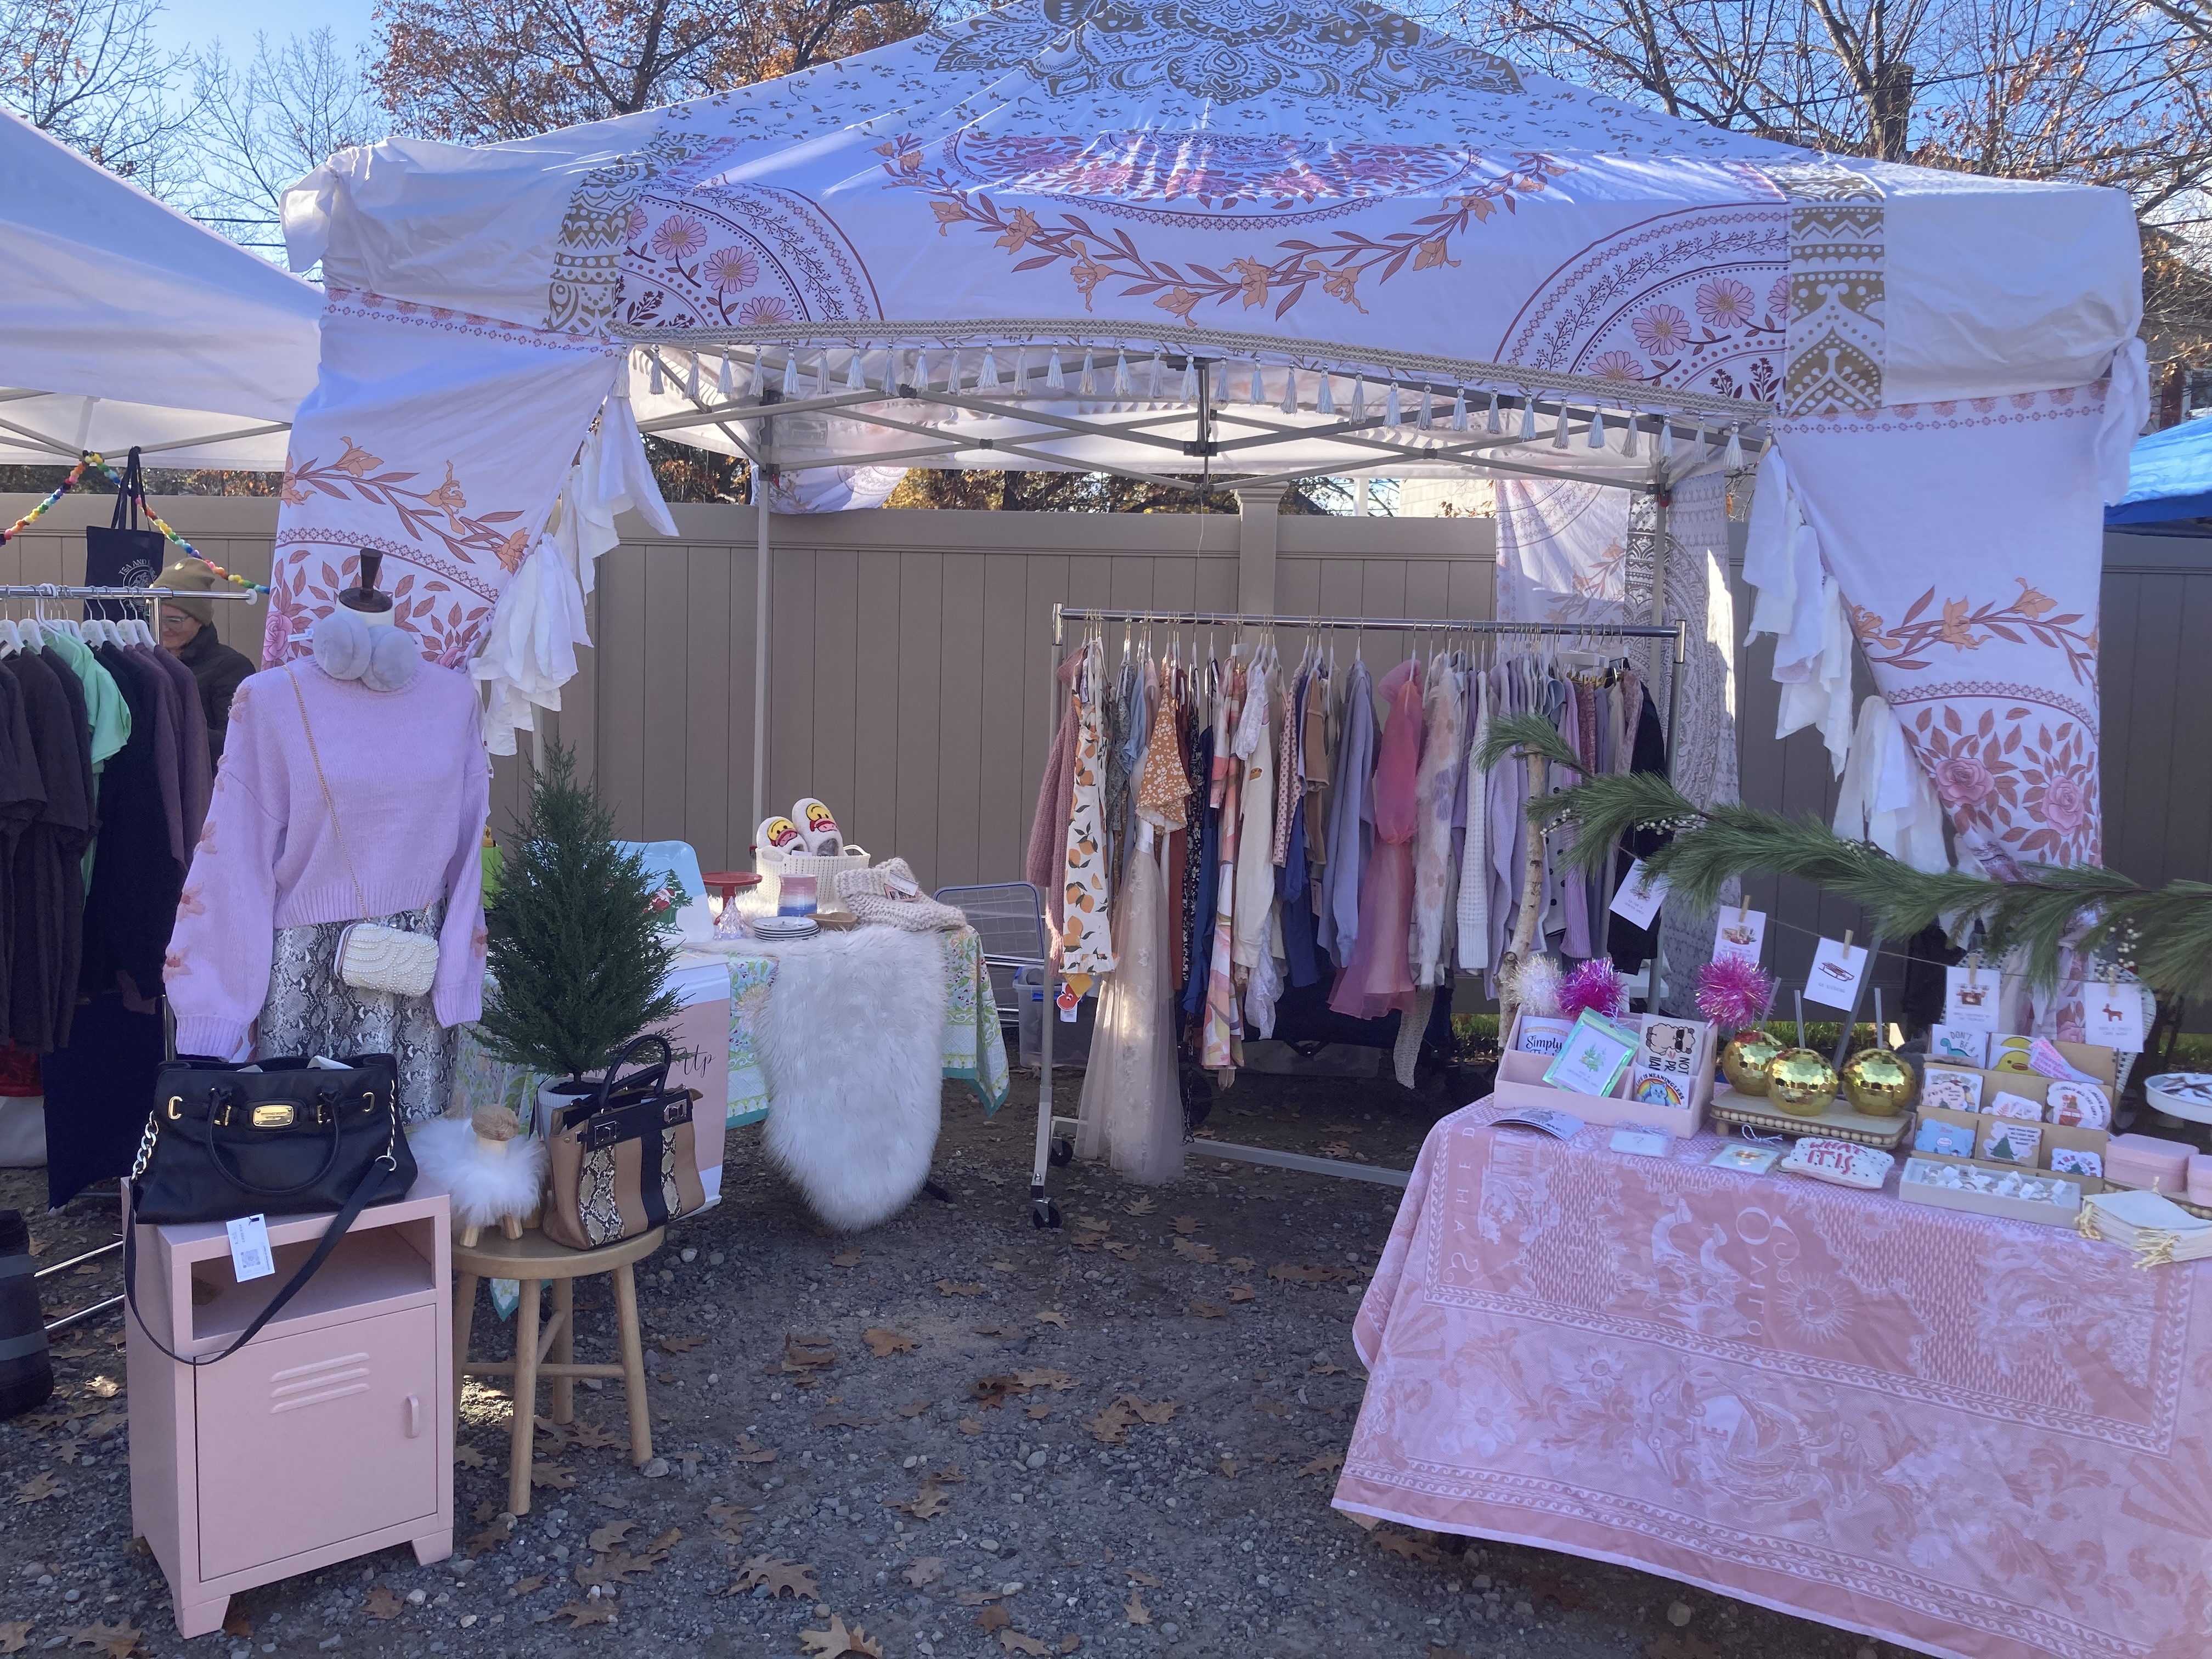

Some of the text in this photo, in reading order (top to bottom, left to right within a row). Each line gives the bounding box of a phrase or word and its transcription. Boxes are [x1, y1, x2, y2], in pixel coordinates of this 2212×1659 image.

[1526, 1035, 1562, 1053] Simply
[1950, 1031, 1973, 1041] DON'T
[1960, 1040, 1969, 1049] BE
[1678, 1057, 1690, 1075] NOT
[1648, 1073, 1685, 1100] MEANINGLESS
[1808, 1150, 1854, 1175] IT IS
